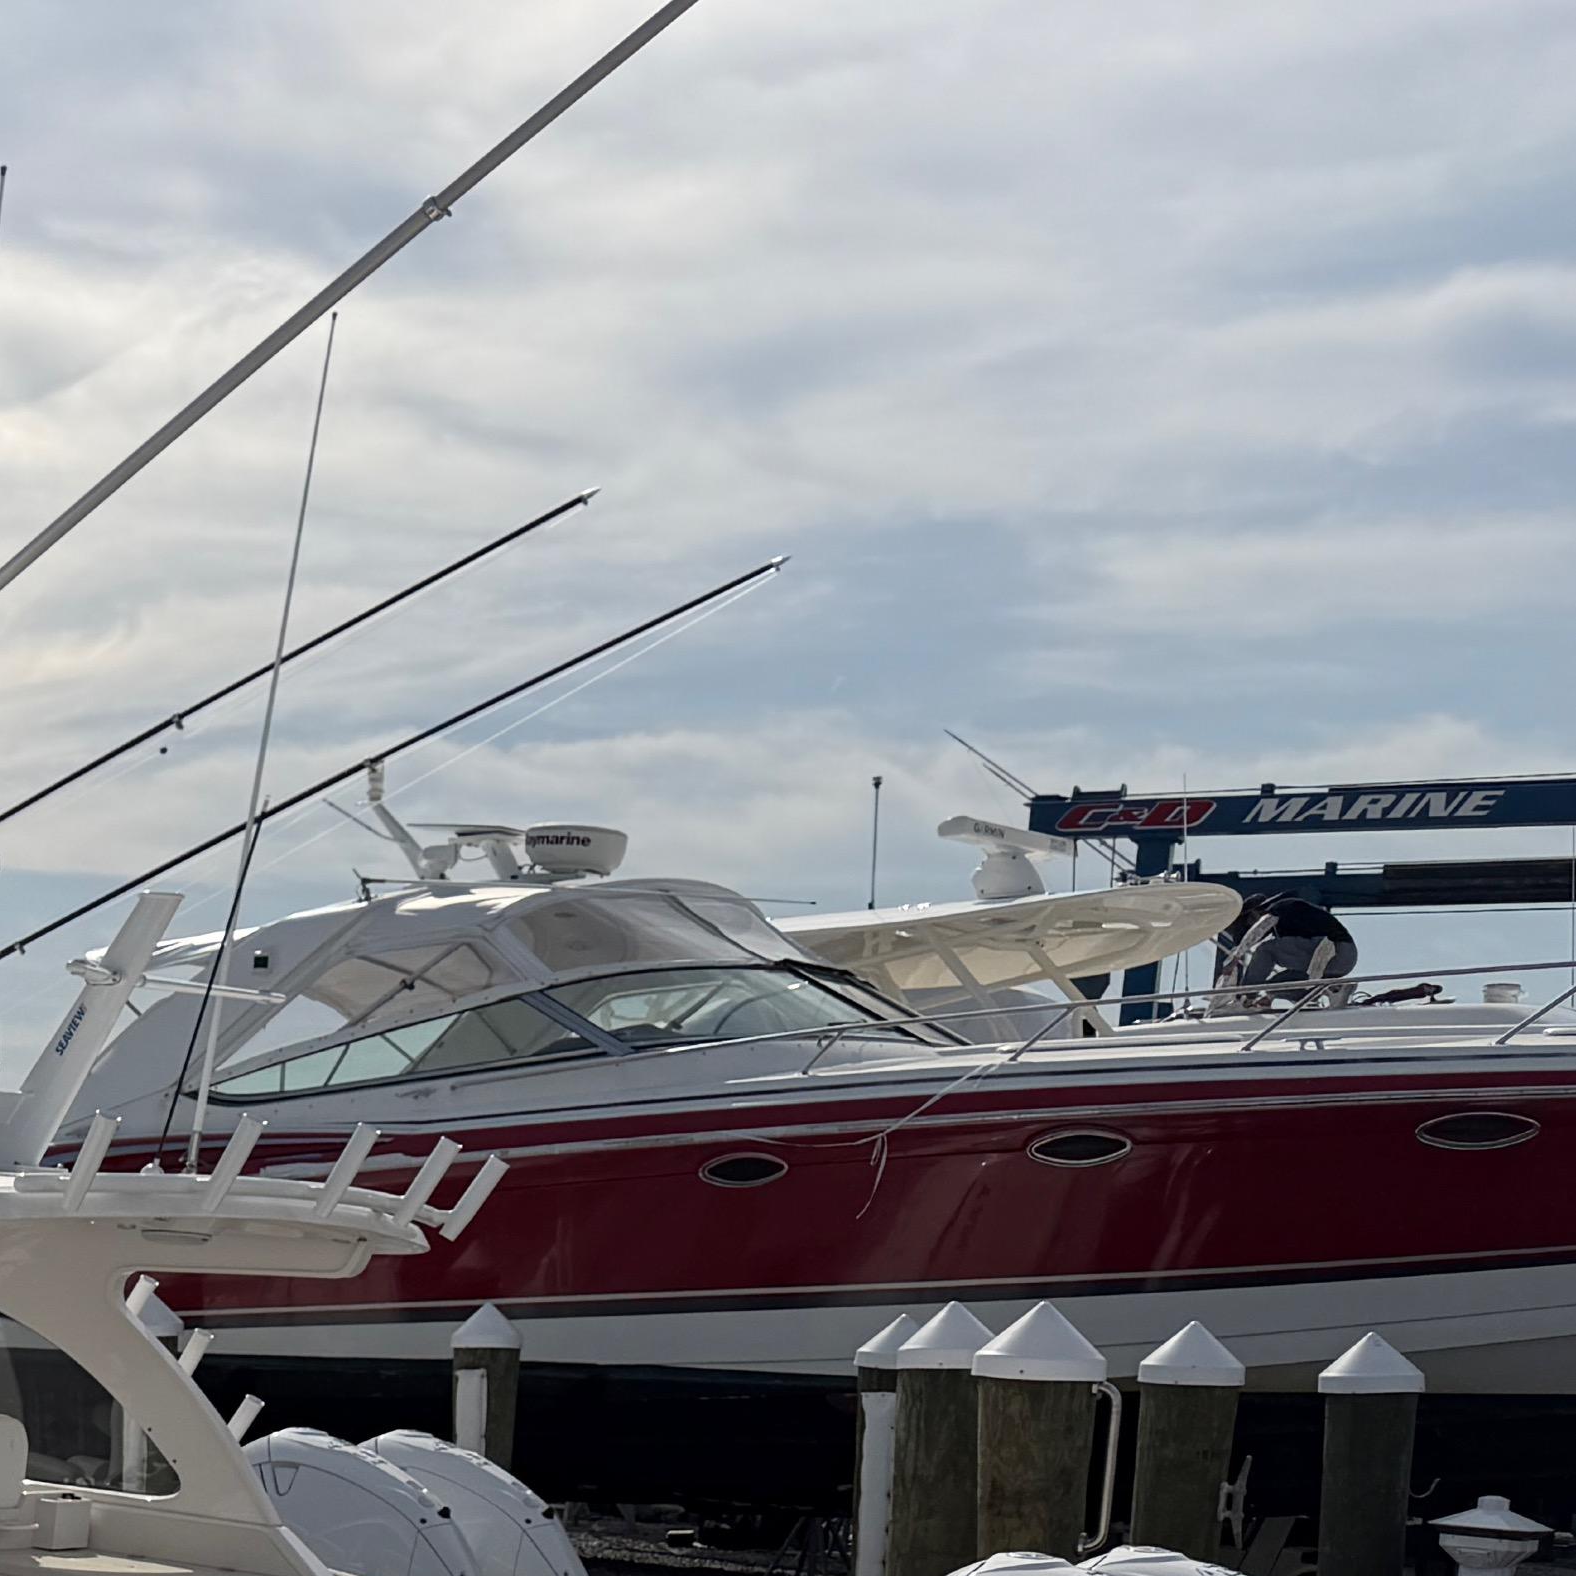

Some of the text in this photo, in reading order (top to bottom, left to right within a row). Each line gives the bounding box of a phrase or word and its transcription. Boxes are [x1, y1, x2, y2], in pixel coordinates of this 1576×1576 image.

[1055, 789, 1505, 832] C&D MARINE
[55, 1005, 86, 1057] SEAVIEW
